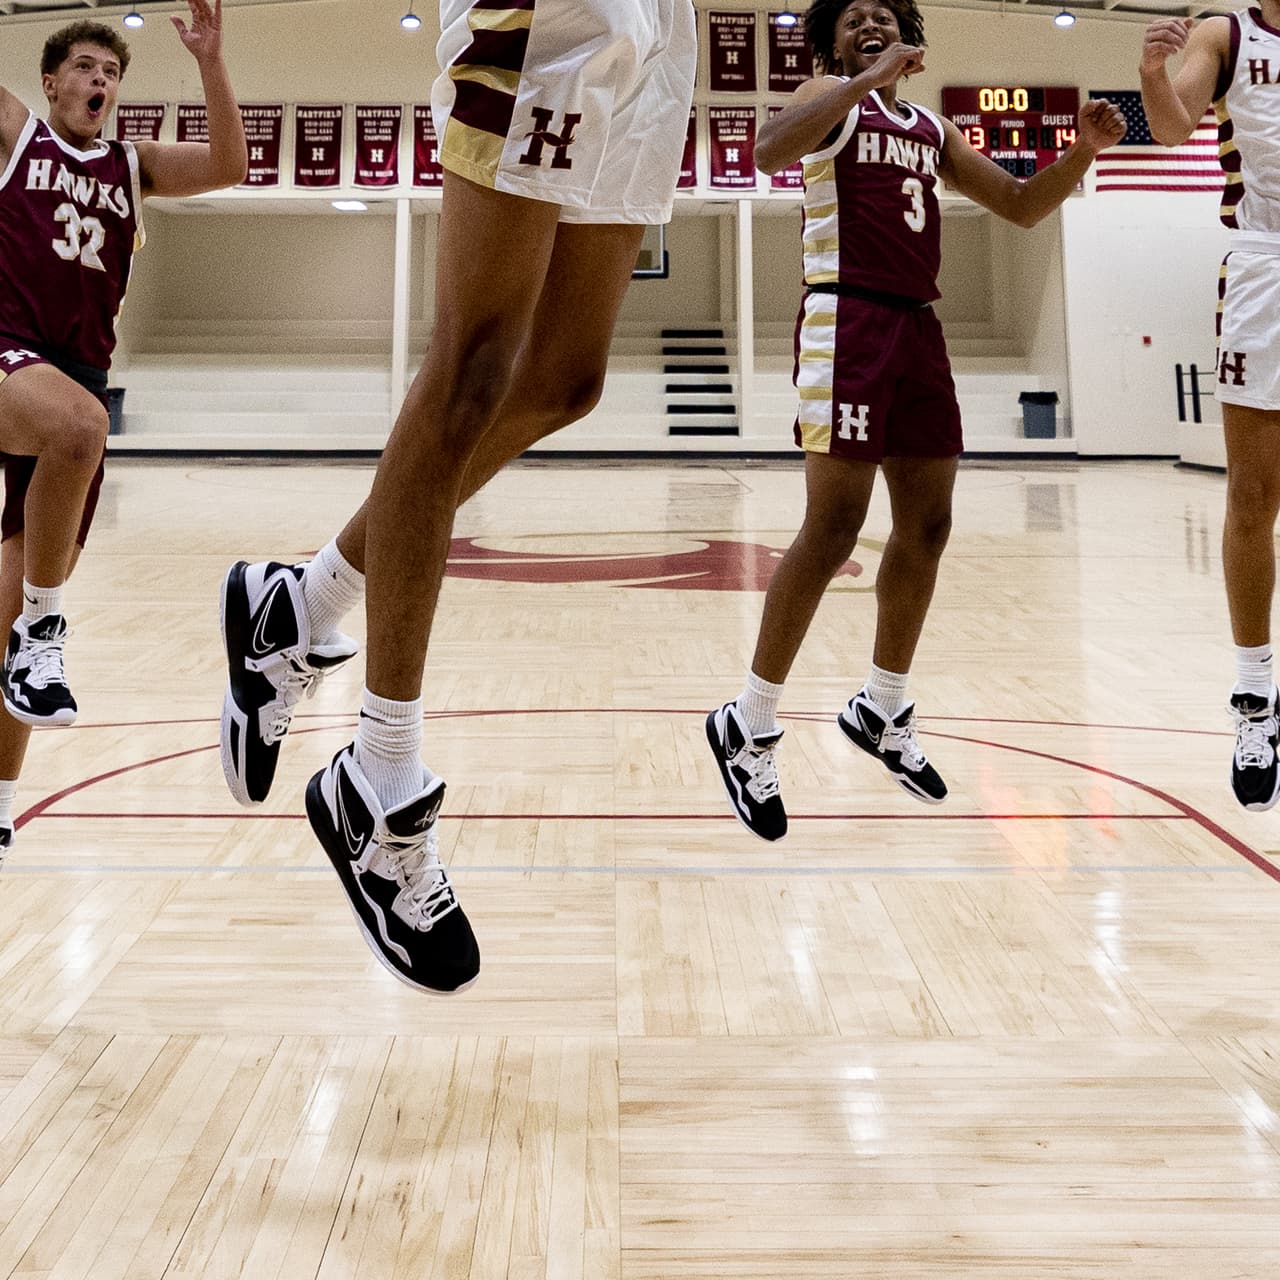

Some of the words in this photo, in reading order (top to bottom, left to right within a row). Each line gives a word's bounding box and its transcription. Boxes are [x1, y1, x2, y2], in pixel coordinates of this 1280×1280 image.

[726, 51, 739, 64] H
[785, 54, 798, 67] H
[978, 88, 1028, 111] 00.0
[297, 110, 342, 118] HARTFIELD
[357, 109, 401, 118] HARTFIELD
[952, 115, 981, 125] HOME
[1042, 115, 1074, 125] GUEST
[1000, 120, 1025, 128] PERIOD
[519, 106, 582, 170] H
[1011, 130, 1020, 147] 1
[1055, 128, 1076, 148] 14
[250, 147, 264, 160] H
[312, 148, 325, 161] H
[371, 149, 384, 163] H
[725, 148, 739, 162] H
[856, 132, 939, 176] HAWK
[991, 151, 1017, 159] PLAYER
[1020, 151, 1037, 159] FOUL
[25, 158, 130, 219] HAWKS
[901, 177, 926, 233] 3
[52, 202, 108, 272] 32
[1219, 351, 1246, 386] H
[837, 403, 870, 441] H
